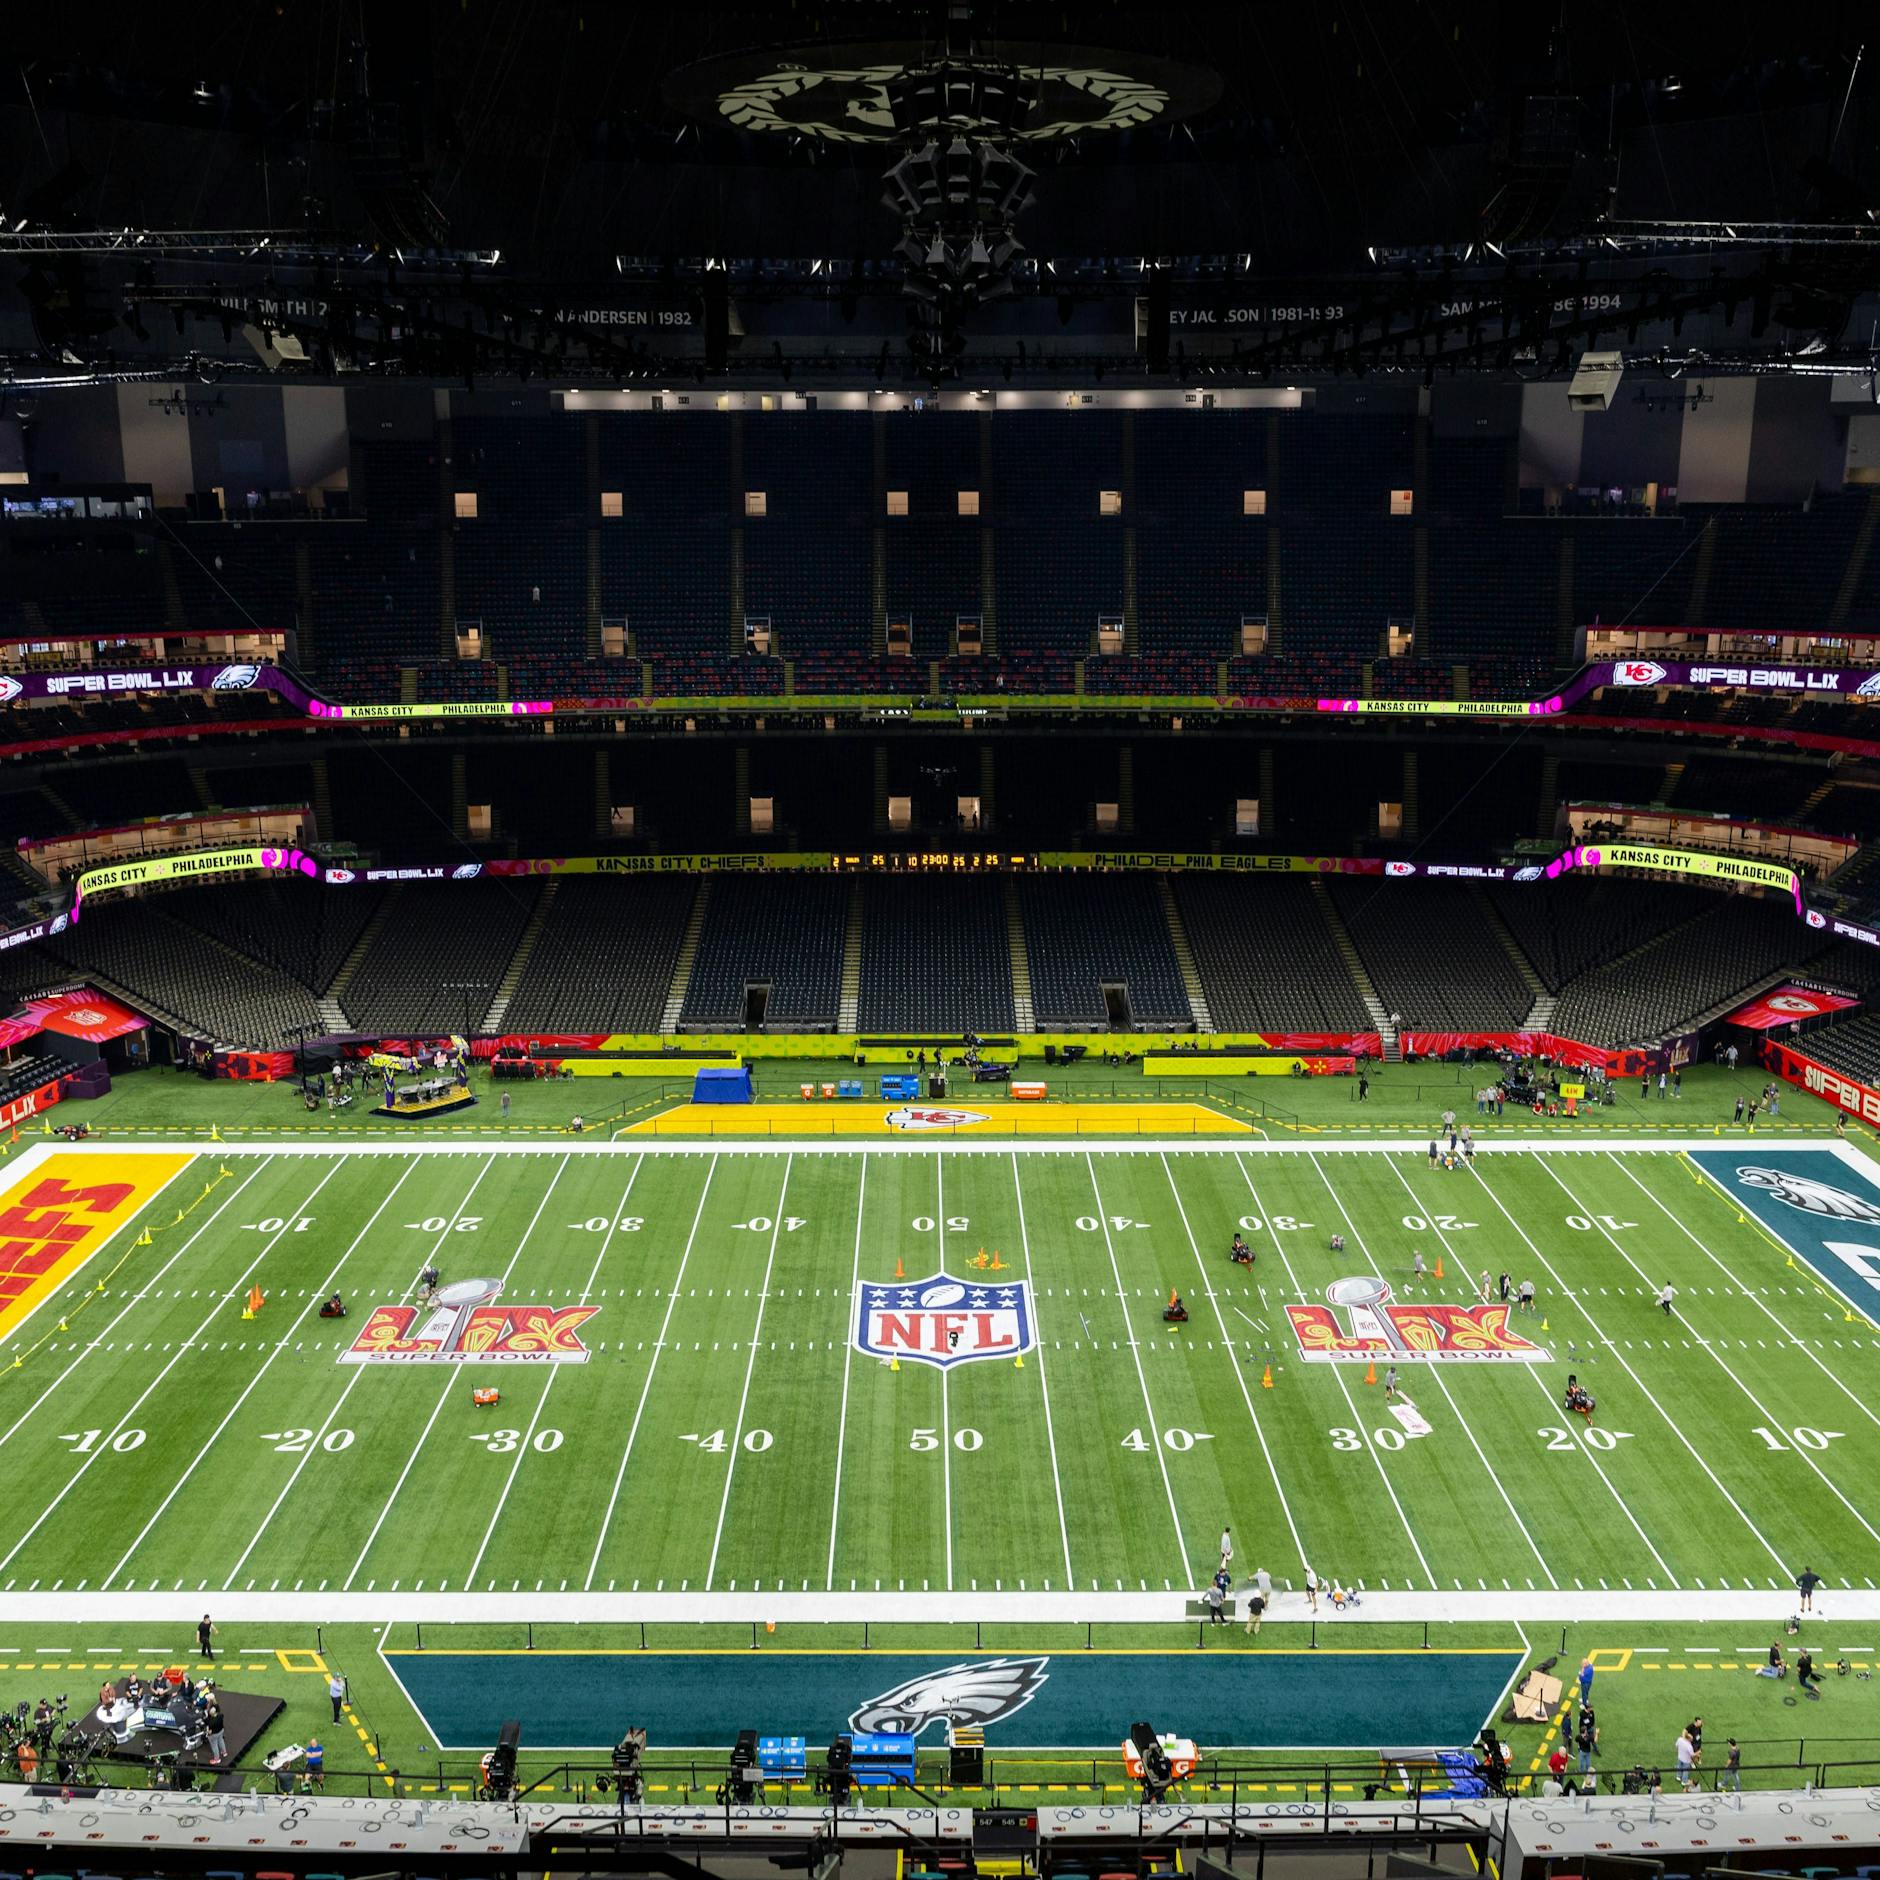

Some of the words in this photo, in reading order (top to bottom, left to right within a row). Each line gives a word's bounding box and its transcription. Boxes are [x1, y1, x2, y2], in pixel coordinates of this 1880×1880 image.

[657, 312, 692, 326] 1982
[1190, 308, 1259, 323] JACSON
[47, 674, 106, 693] SUPER
[108, 672, 162, 690] BOWL
[163, 670, 194, 687] LIX
[1689, 667, 1747, 685] SUPER
[1749, 669, 1805, 688] BOWL
[1806, 672, 1840, 690] LIX
[351, 707, 389, 717] KANSAS
[392, 706, 414, 715] CITY
[442, 704, 506, 714] PHILADELPHIA
[1367, 702, 1404, 712] KANSAS
[1407, 702, 1430, 712] CITY
[1458, 703, 1523, 713] PHILADELPHIA
[596, 857, 655, 871] KANSAS
[661, 857, 694, 869] CITY
[700, 855, 765, 868] CHIEFS
[872, 854, 885, 866] 25
[908, 856, 919, 867] 10
[922, 854, 949, 866] 23:00
[953, 856, 966, 867] 25
[986, 854, 999, 866] 25
[1095, 854, 1212, 868] PHILADELPHIA
[1220, 856, 1291, 869] EAGLES
[1611, 850, 1659, 864] KANSAS
[1663, 855, 1691, 868] CITY
[1716, 861, 1789, 886] PHILADELPHIA
[83, 872, 117, 889] KANSAS
[121, 867, 147, 882] CITY
[172, 854, 253, 872] PHILADELPHIA
[367, 870, 398, 881] SUPER
[398, 869, 427, 880] BOWL
[427, 868, 444, 879] LIX
[1427, 865, 1458, 876] SUPER
[1458, 866, 1488, 877] BOWL
[1488, 868, 1505, 878] LIX
[1804, 1064, 1860, 1113] SUPER
[11, 1093, 36, 1122] LIX
[257, 1216, 316, 1232] 10
[420, 1216, 482, 1232] 20
[584, 1216, 644, 1232] 30
[748, 1216, 807, 1232] 40
[912, 1216, 970, 1232] 50
[1075, 1216, 1133, 1232] 40
[1239, 1216, 1297, 1232] 30
[1401, 1216, 1463, 1232] 20
[1564, 1216, 1624, 1232] 10
[875, 1313, 1013, 1354] NFL
[368, 1353, 467, 1361] SUPER
[480, 1353, 561, 1361] BOWL
[1328, 1352, 1427, 1360] SUPER
[1439, 1352, 1524, 1360] BOWL
[69, 1429, 147, 1452] 10
[273, 1429, 355, 1452] 20
[486, 1429, 564, 1452] 30
[698, 1429, 774, 1452] 40
[909, 1429, 984, 1452] 50
[1120, 1429, 1194, 1452] 40
[1328, 1428, 1406, 1452] 30
[1536, 1428, 1617, 1452] 20
[1751, 1428, 1829, 1452] 10
[979, 1818, 993, 1827] 547
[1001, 1818, 1016, 1827] 545
